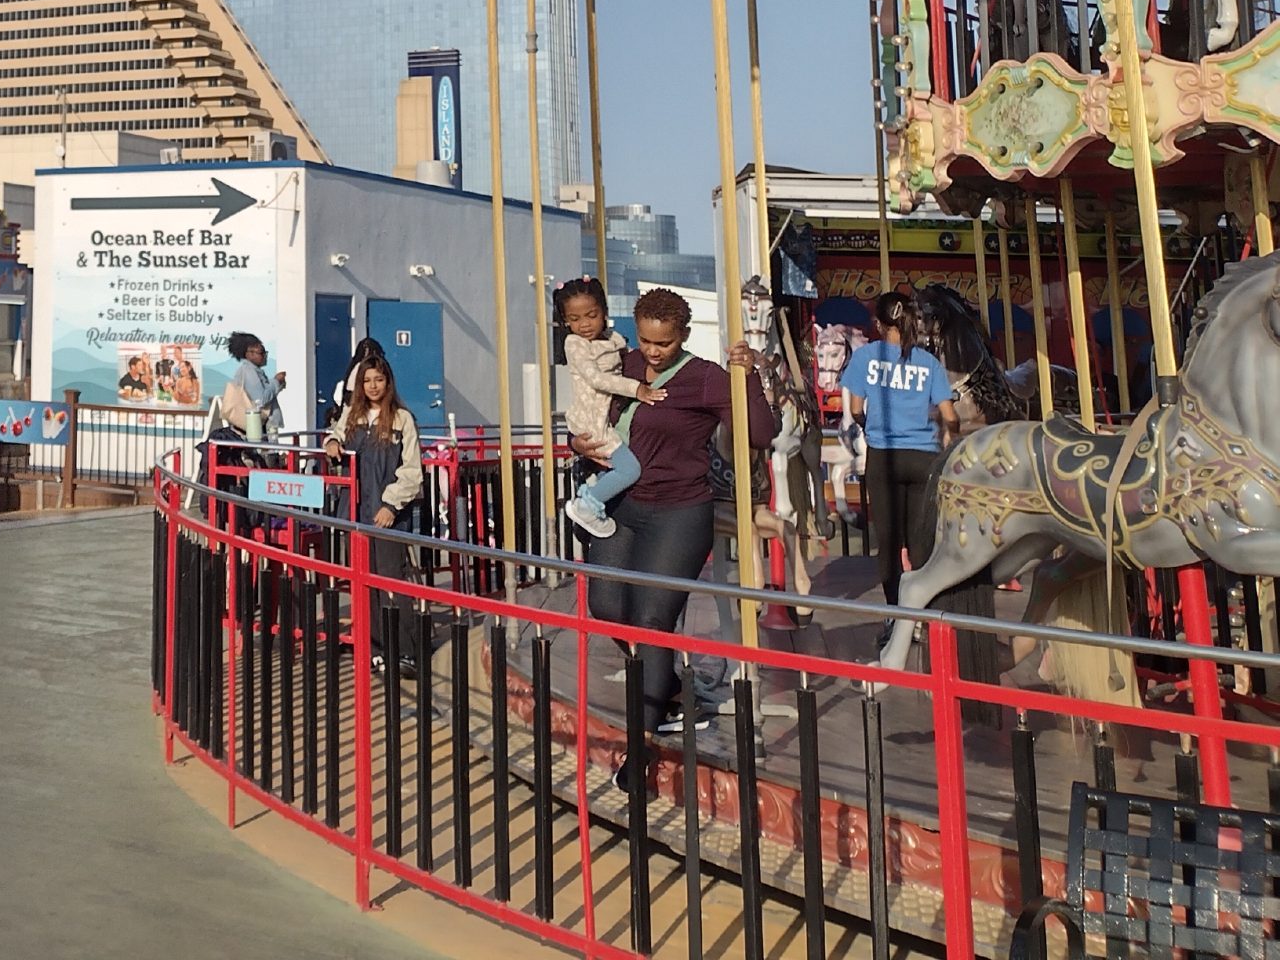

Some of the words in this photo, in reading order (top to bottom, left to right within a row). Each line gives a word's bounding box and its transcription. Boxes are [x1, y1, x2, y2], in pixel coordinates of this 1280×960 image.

[441, 85, 452, 160] ISLAND
[91, 230, 147, 246] Ocean
[153, 229, 194, 246] Reef
[200, 230, 233, 246] Bar
[76, 251, 88, 268] &
[94, 250, 132, 268] The
[137, 250, 208, 268] Sunset
[213, 251, 250, 268] Bar
[117, 279, 159, 291] Frozen
[163, 279, 205, 292] Drinks
[122, 294, 151, 306] Beer
[155, 294, 165, 307] is
[169, 294, 199, 307] Cold
[106, 308, 151, 321] Seltzer
[155, 309, 165, 322] is
[169, 310, 214, 326] Bubbly
[86, 327, 157, 349] Relaxation
[160, 330, 171, 344] in
[173, 332, 206, 350] every
[866, 359, 930, 392] STAFF
[267, 481, 304, 496] EXIT
